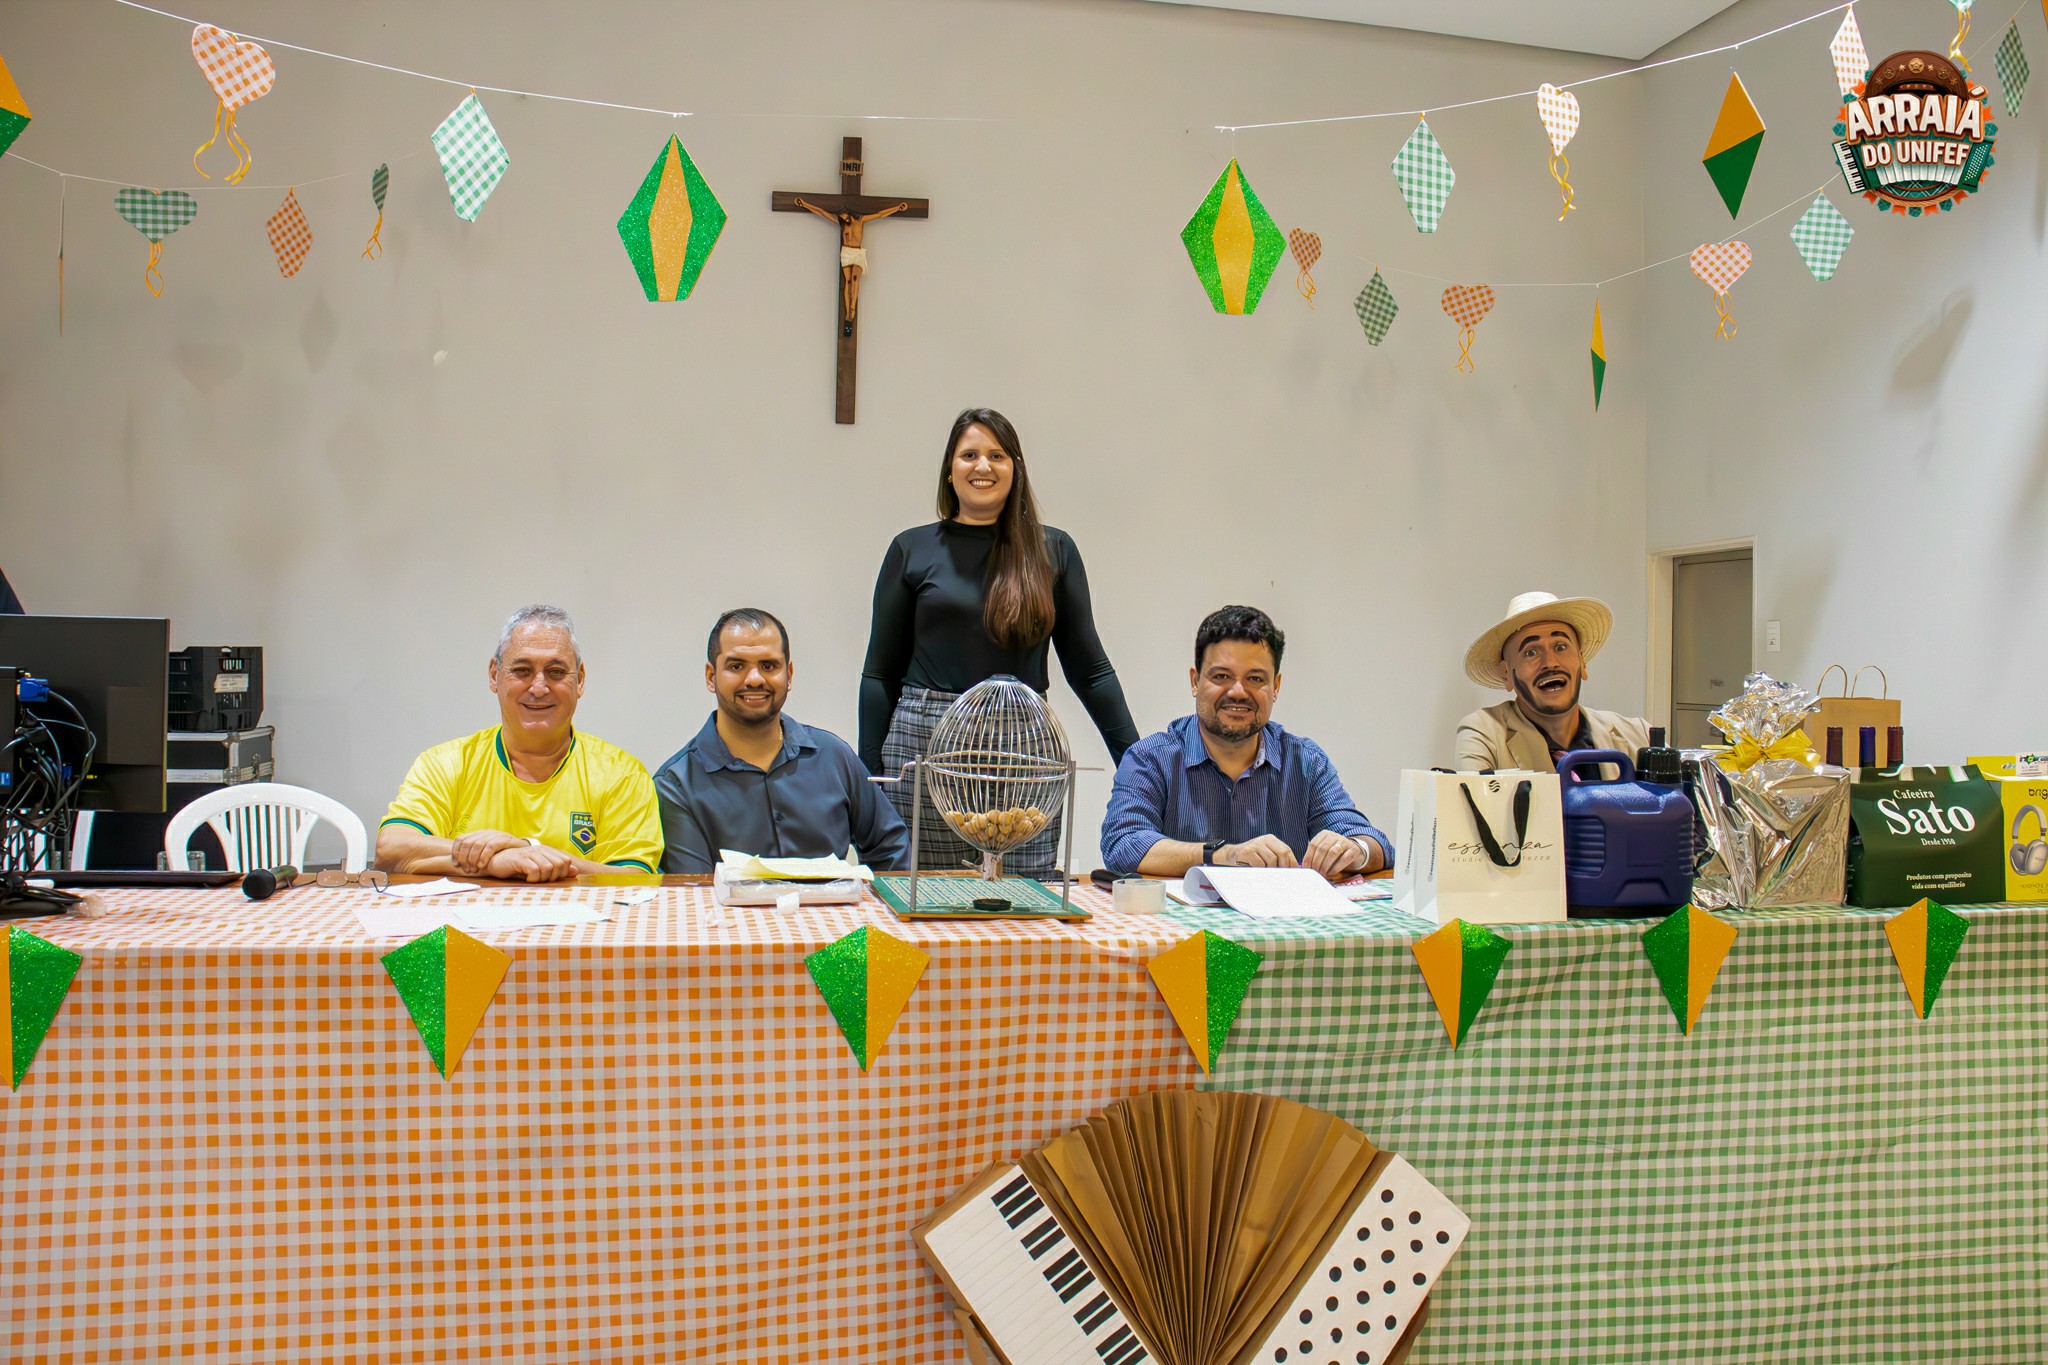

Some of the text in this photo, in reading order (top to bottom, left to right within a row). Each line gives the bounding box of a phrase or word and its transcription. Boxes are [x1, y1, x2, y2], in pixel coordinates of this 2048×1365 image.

[842, 162, 861, 172] INRI
[1893, 789, 1935, 799] Cafeeira
[1877, 798, 1976, 835] Sato
[1920, 838, 1941, 846] Desde
[1448, 841, 1553, 855] essnza
